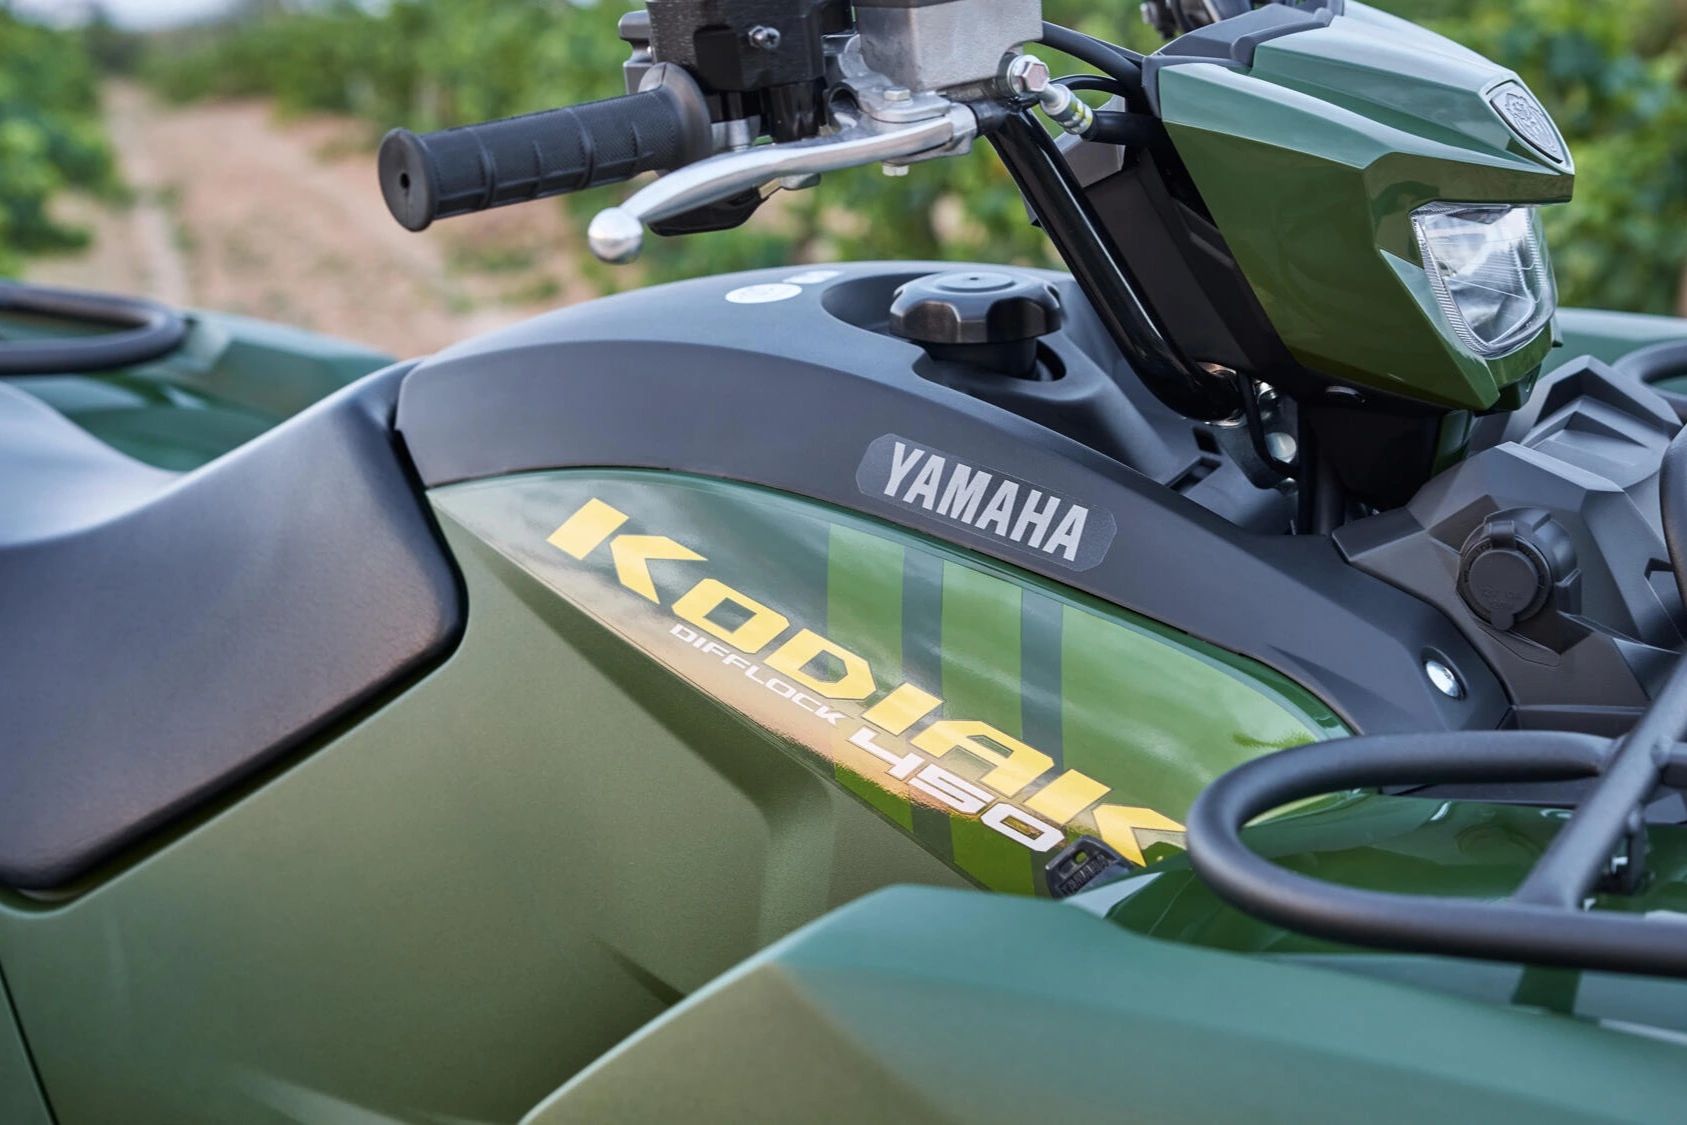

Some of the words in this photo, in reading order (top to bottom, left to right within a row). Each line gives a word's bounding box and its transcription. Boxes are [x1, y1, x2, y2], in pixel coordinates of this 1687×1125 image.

[882, 441, 1089, 562] YAMAHA
[547, 498, 1187, 867] KODIAK
[669, 623, 847, 725] DIFFLOCK
[849, 728, 1065, 853] 450
